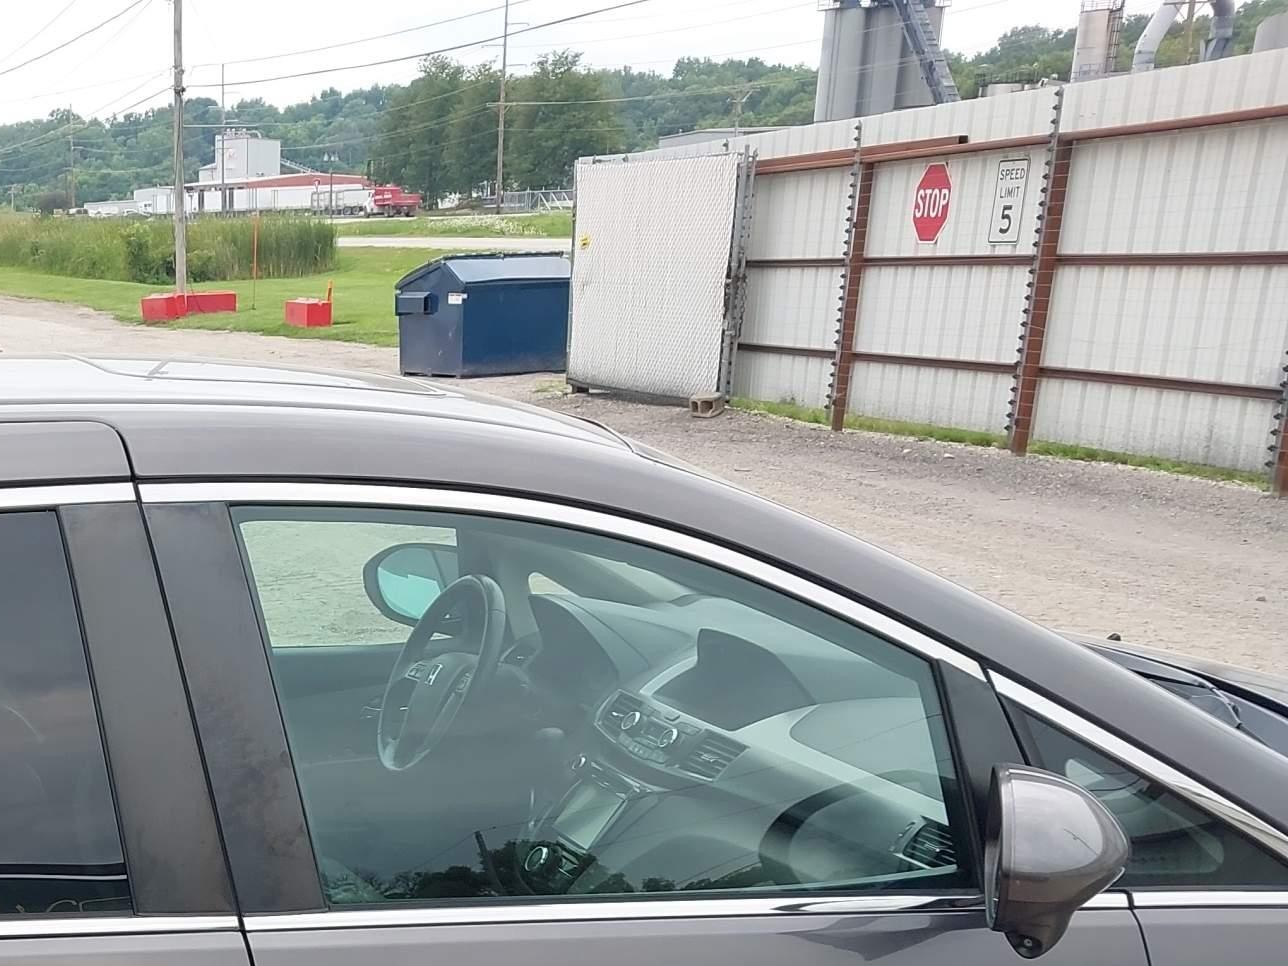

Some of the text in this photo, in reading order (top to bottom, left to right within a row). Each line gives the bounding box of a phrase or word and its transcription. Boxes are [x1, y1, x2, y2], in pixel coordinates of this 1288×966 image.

[999, 167, 1026, 181] SPEED
[915, 188, 949, 218] STOP
[999, 186, 1021, 199] LIMIT
[998, 204, 1013, 234] 5
